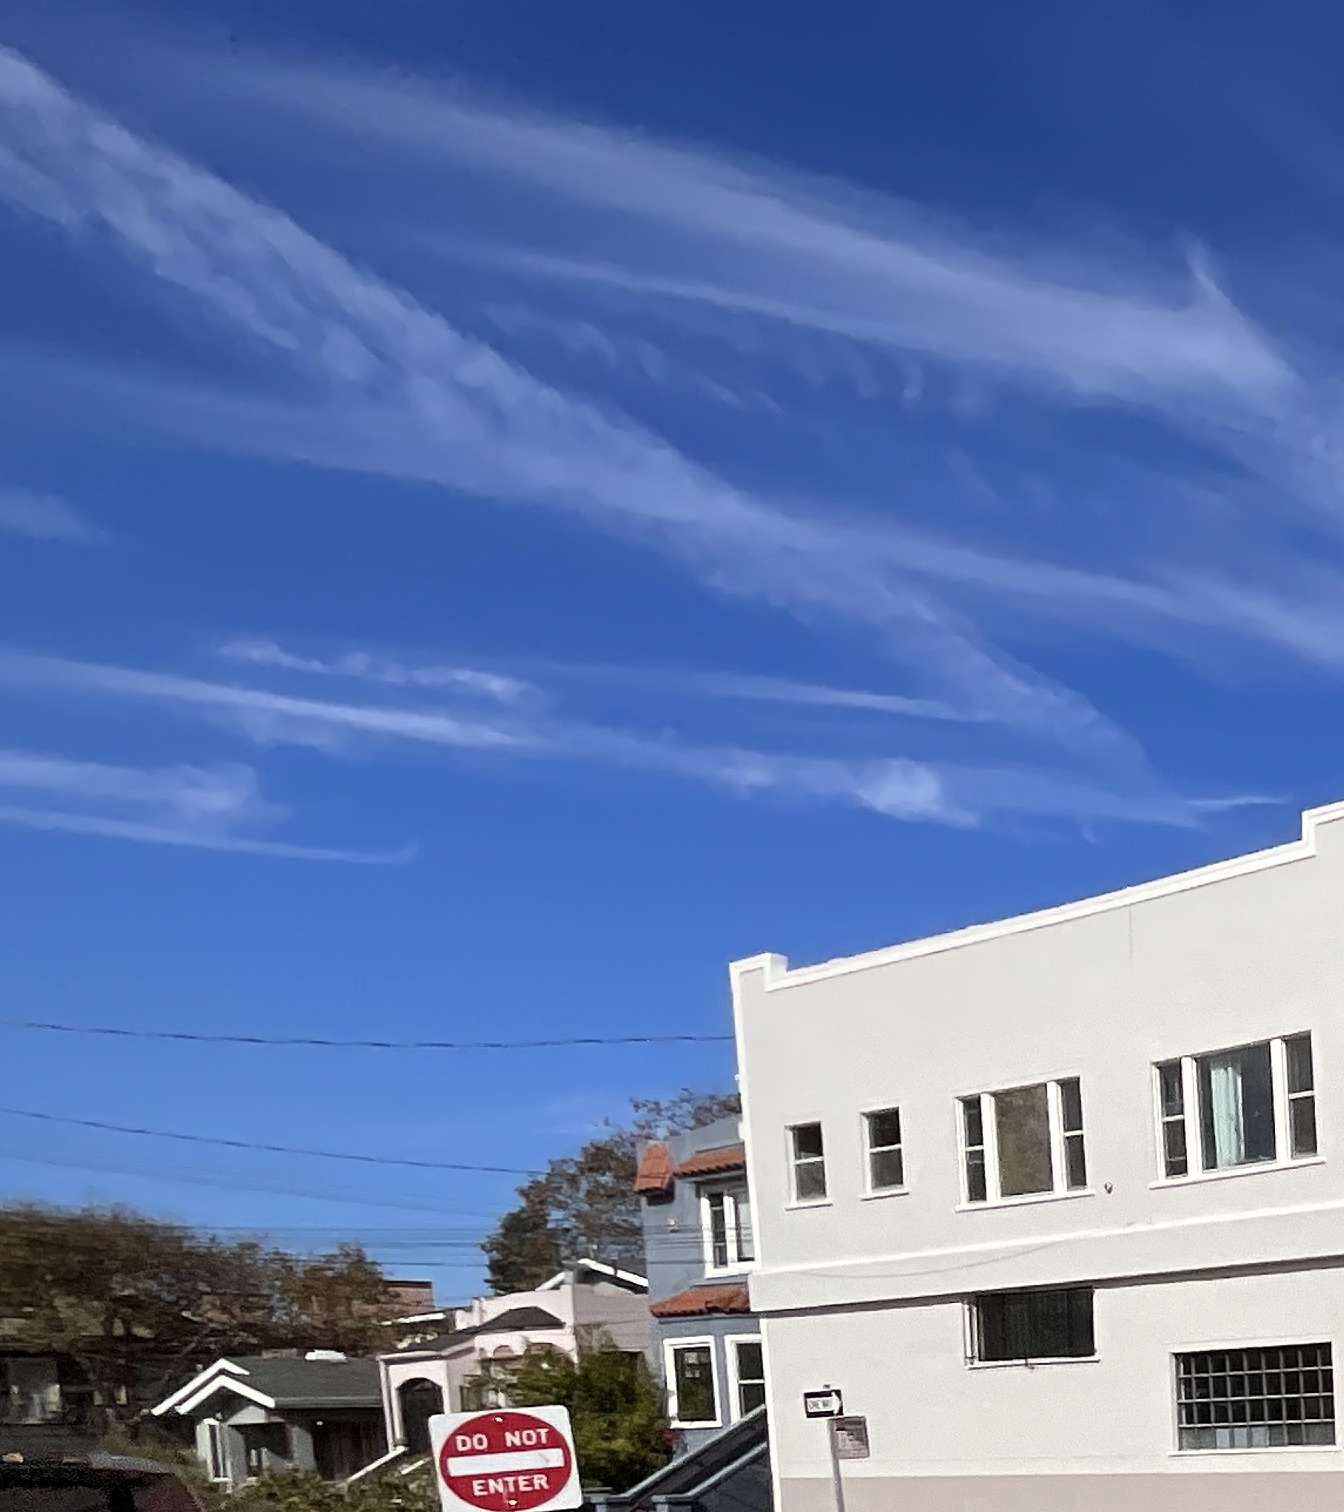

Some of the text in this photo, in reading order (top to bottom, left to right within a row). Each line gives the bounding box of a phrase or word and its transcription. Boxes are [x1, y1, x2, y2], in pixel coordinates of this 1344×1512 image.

[455, 1428, 549, 1451] DO NOT
[472, 1474, 549, 1497] ENTER
